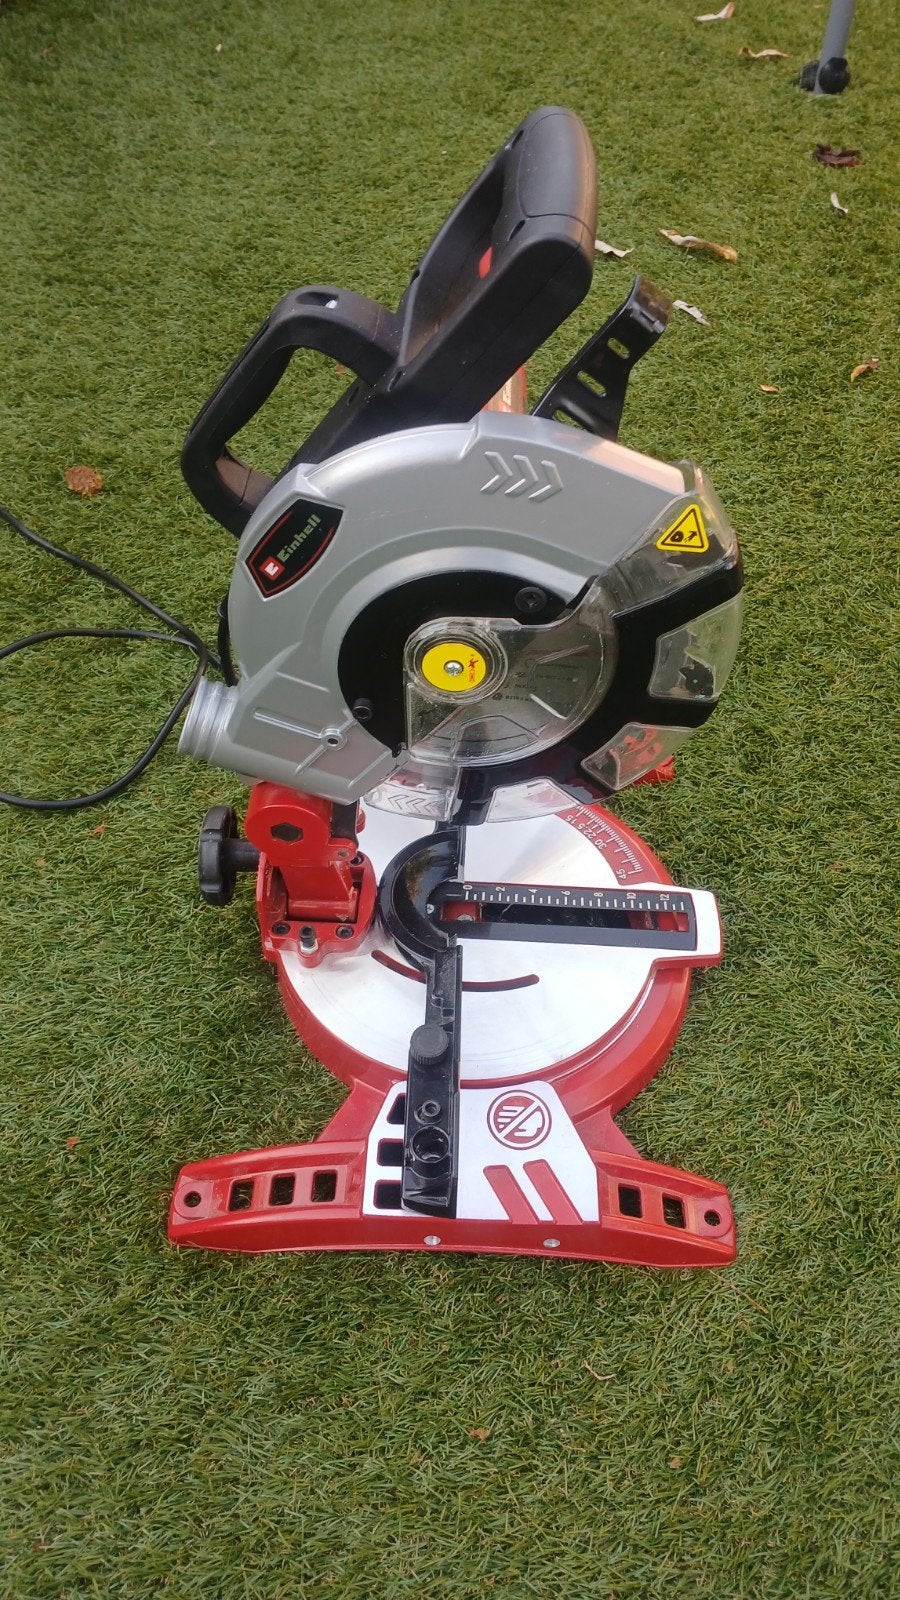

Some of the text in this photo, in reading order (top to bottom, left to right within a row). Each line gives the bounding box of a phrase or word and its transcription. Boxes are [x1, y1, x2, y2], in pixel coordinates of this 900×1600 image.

[277, 514, 321, 562] Einhell
[565, 814, 576, 824] 15
[594, 839, 607, 850] 30
[616, 868, 627, 879] 45
[626, 892, 637, 900] 10
[659, 893, 670, 901] 12
